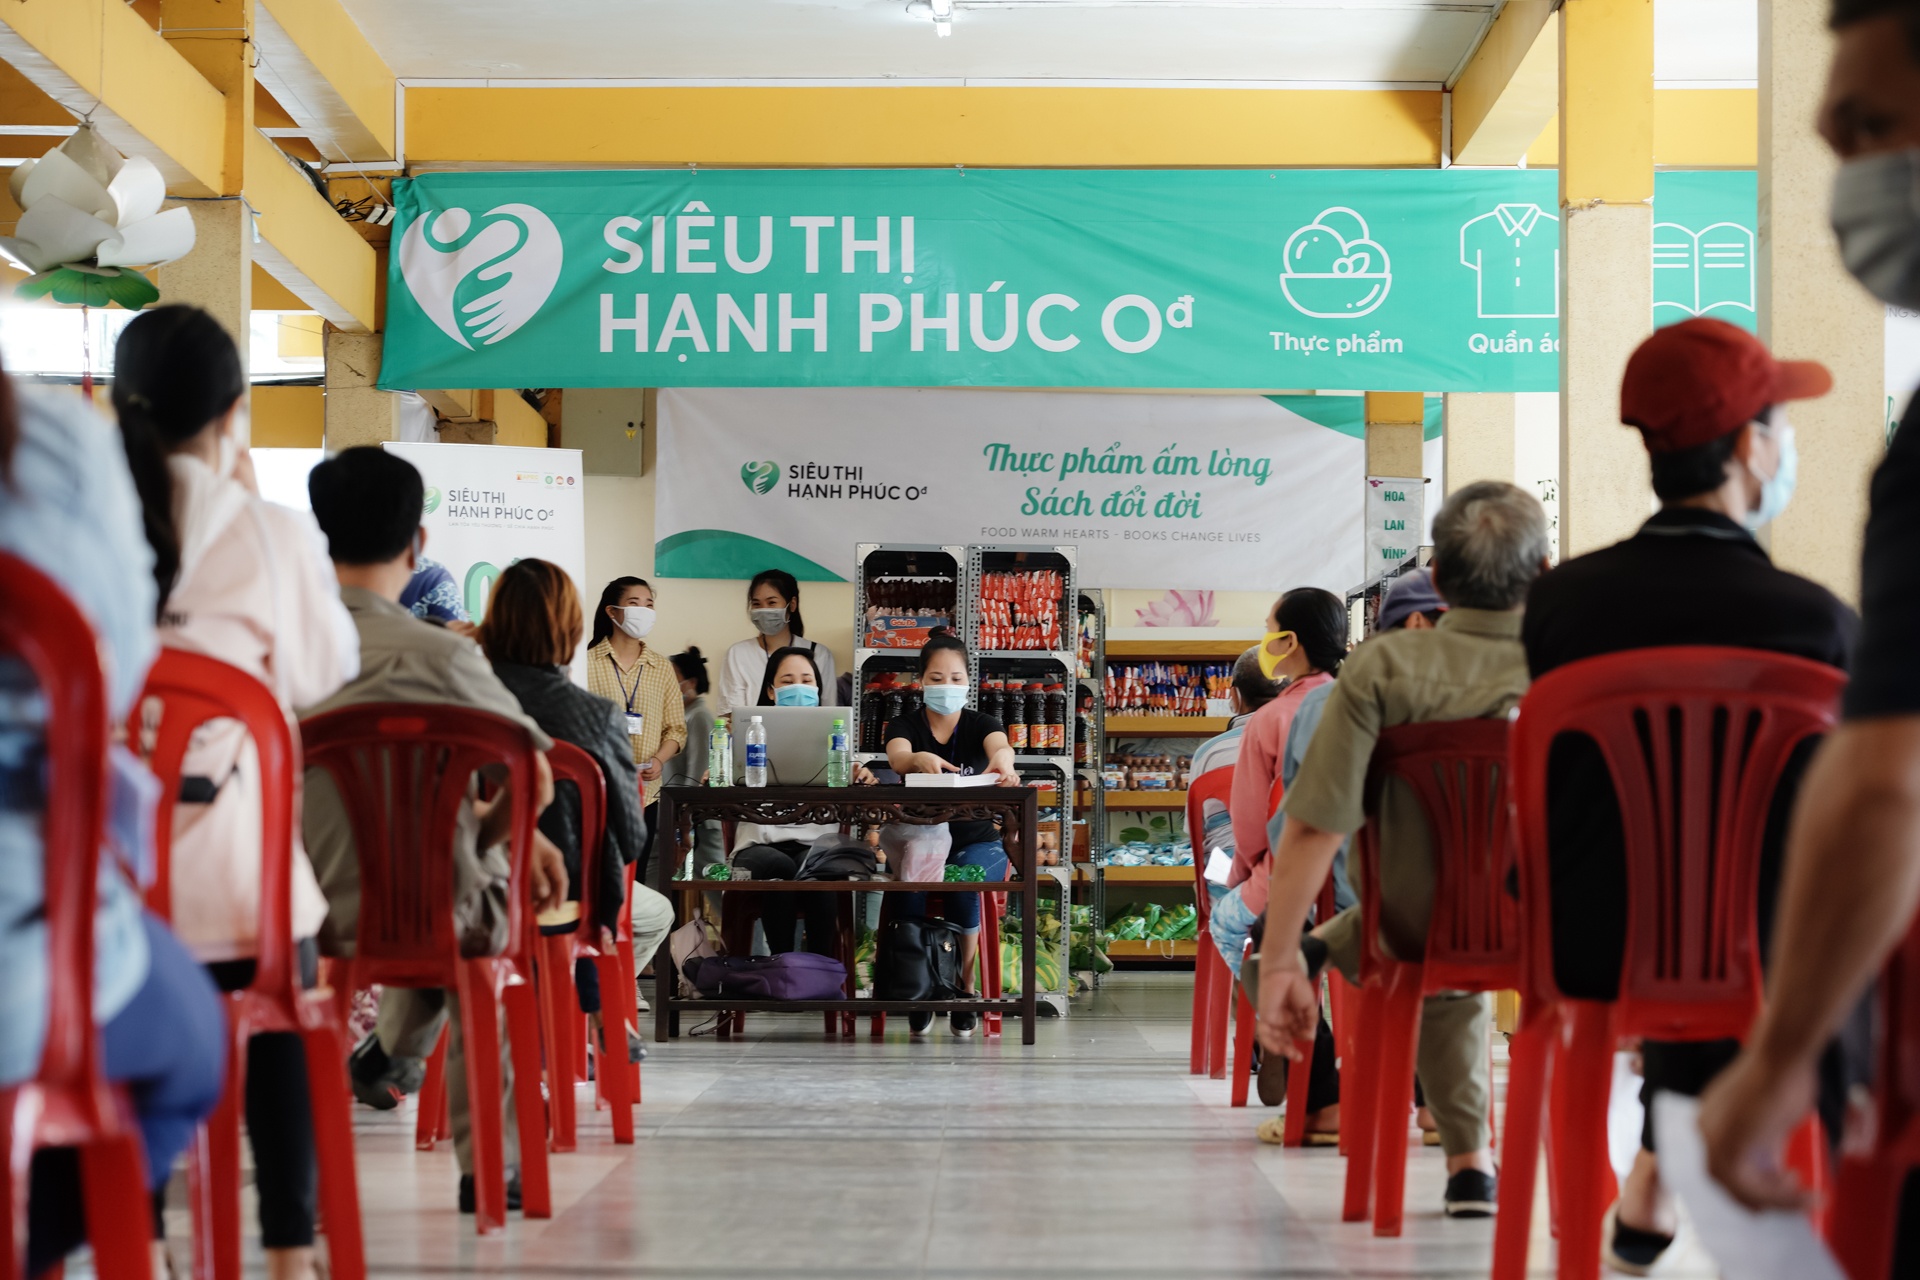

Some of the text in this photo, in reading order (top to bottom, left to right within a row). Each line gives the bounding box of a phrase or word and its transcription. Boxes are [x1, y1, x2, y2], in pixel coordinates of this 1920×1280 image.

[602, 200, 915, 285] SIÊU THỊ
[600, 292, 828, 363] HẠNH
[859, 281, 1081, 353] PHÚC
[1269, 328, 1403, 357] Thực phẩm
[1468, 329, 1534, 354] Quần
[789, 461, 863, 483] SIÊU THỊ
[982, 441, 1274, 486] Thực phẩm ấm lòng
[448, 488, 506, 505] SIÊU THỊ
[788, 483, 842, 500] HẠNH
[848, 482, 901, 500] PHÚC
[1020, 484, 1203, 519] Sách đổi đời
[1384, 490, 1406, 502] HOA
[448, 505, 490, 519] HẠNH
[494, 506, 534, 520] PHÚC
[981, 527, 1018, 538] FOOD
[1021, 527, 1060, 538] WARM
[1063, 528, 1109, 540] HEARTS
[1123, 529, 1168, 541] BOOKS
[1171, 530, 1224, 542] CHANGE
[1228, 532, 1261, 543] LIVES
[1384, 519, 1405, 531] LAN
